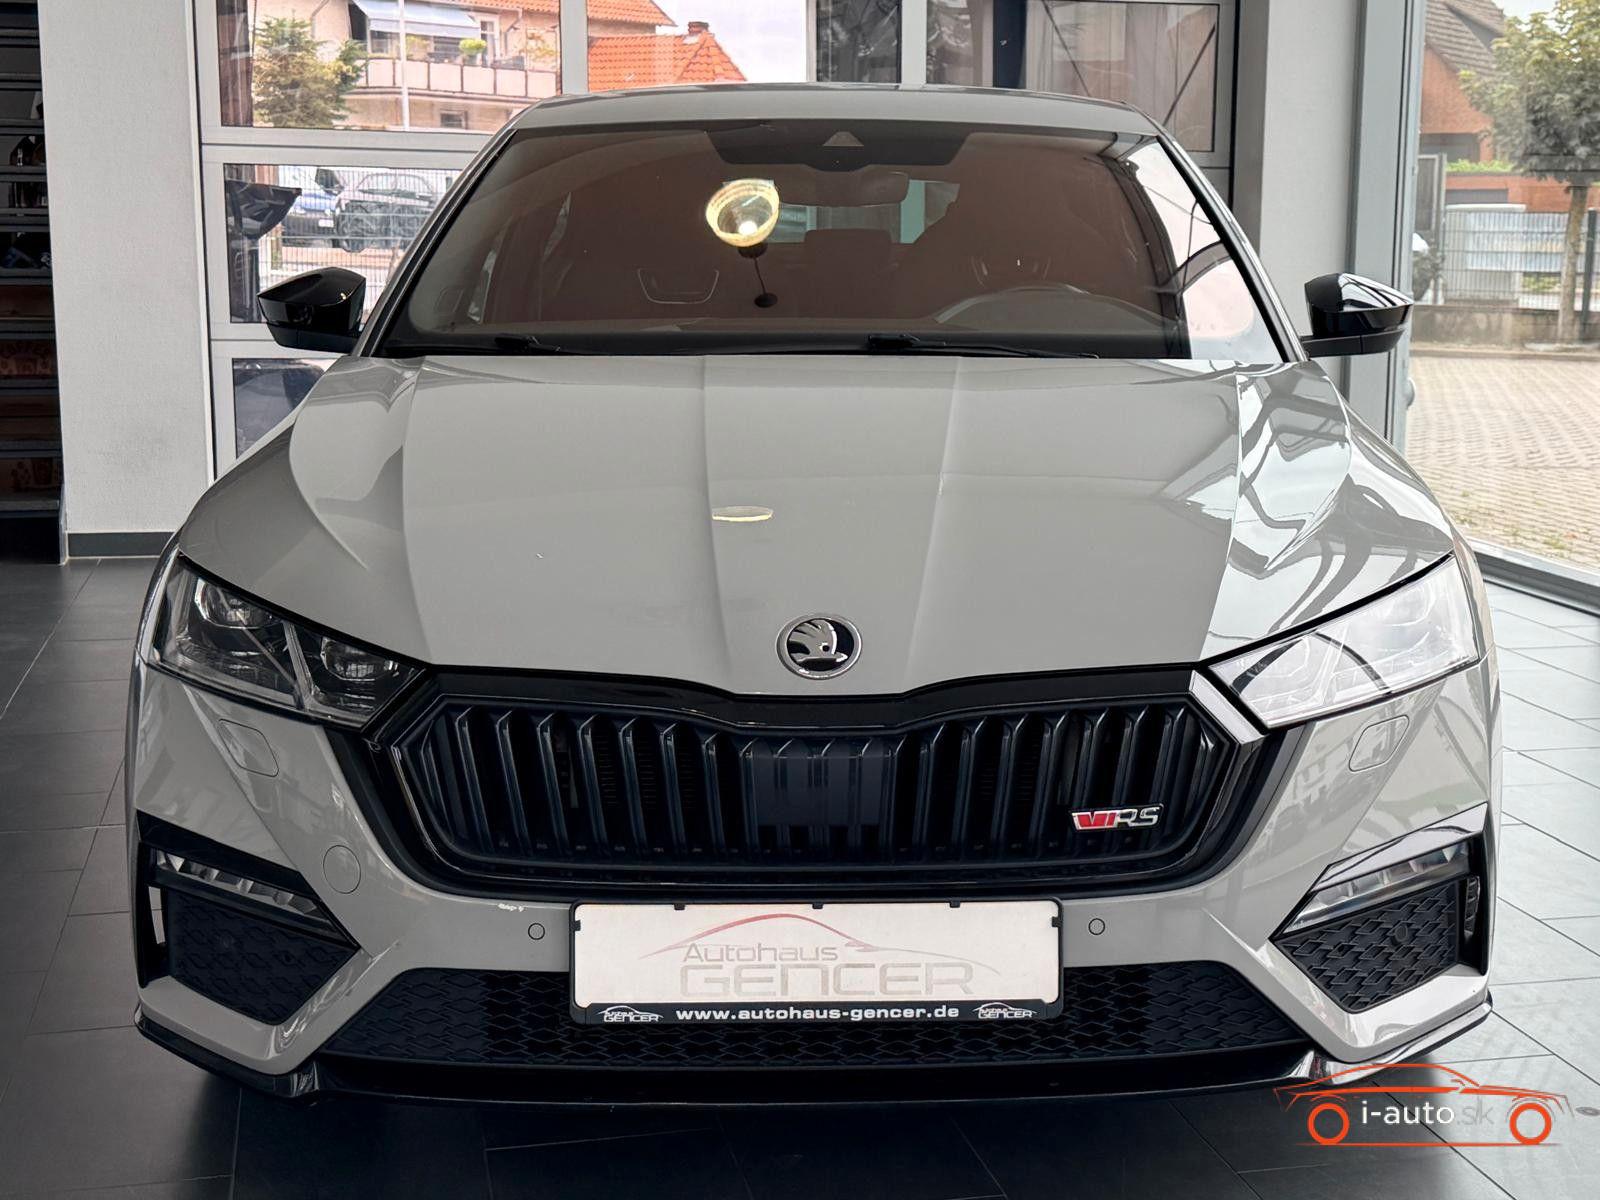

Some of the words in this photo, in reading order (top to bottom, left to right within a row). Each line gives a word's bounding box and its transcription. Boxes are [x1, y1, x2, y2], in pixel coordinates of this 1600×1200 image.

[683, 942, 839, 962] Autohaus
[680, 963, 974, 998] GENCER
[675, 1005, 960, 1022] www.autohaus-gencer.de
